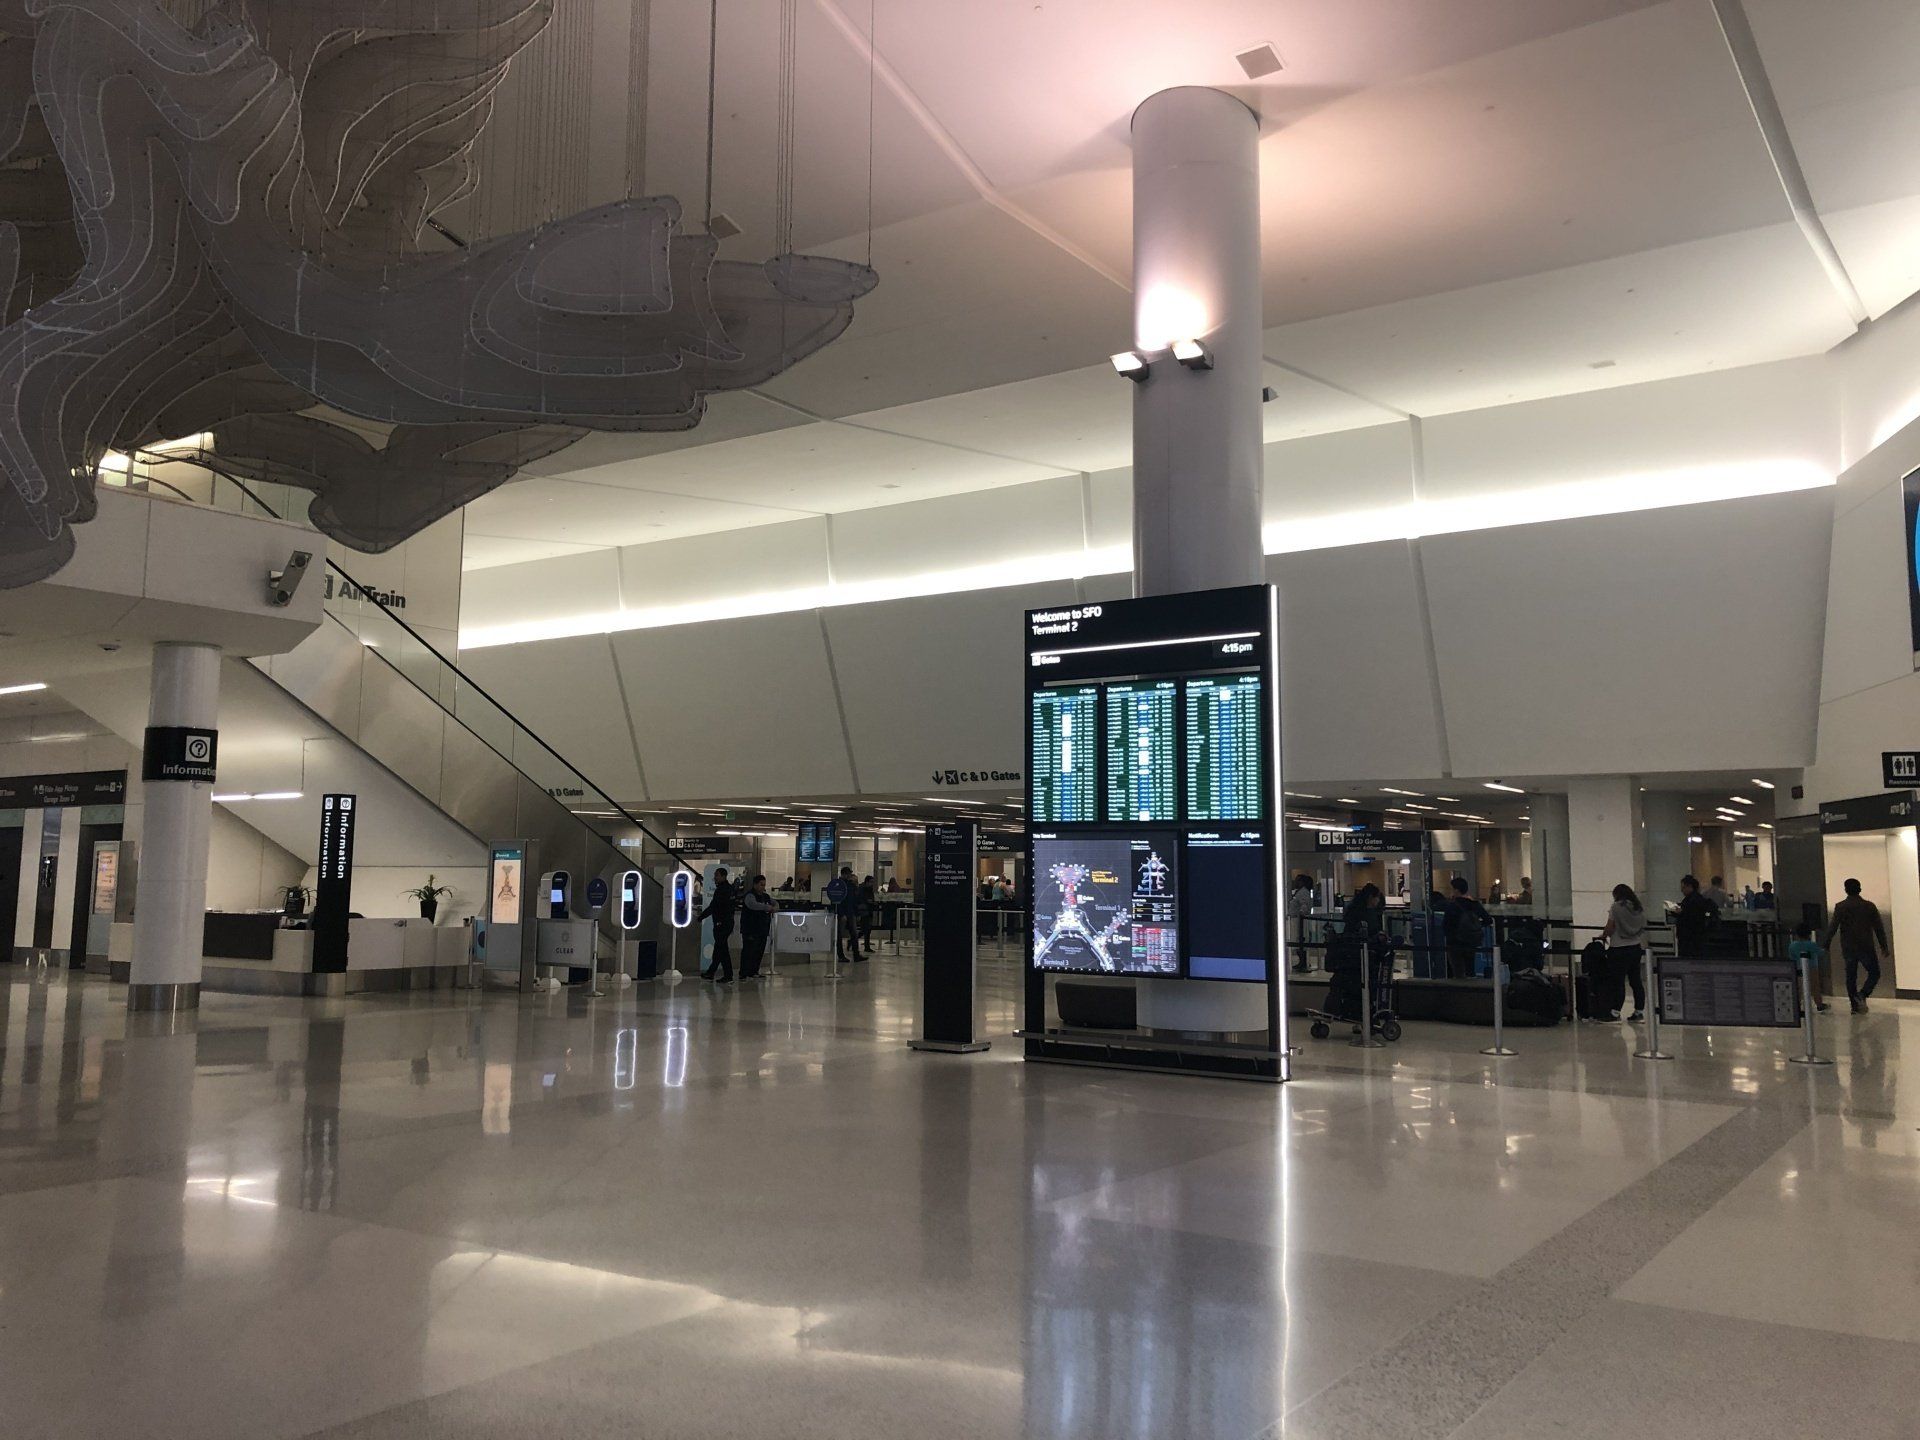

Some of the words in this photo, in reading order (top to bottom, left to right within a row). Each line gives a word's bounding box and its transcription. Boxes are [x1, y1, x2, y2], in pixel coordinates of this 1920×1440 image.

[339, 581, 406, 609] AirTrain
[1032, 612, 1071, 623] Welcome
[1071, 609, 1082, 619] to
[1082, 605, 1103, 618] SFO
[1032, 622, 1071, 635] Terminal
[1071, 621, 1079, 632] 2
[960, 772, 969, 782] C
[970, 771, 979, 782] &
[980, 771, 989, 781] D
[990, 770, 1021, 781] Gates
[556, 788, 563, 797] D
[562, 787, 585, 797] Gates
[321, 812, 332, 879] Information
[337, 812, 350, 879] Information
